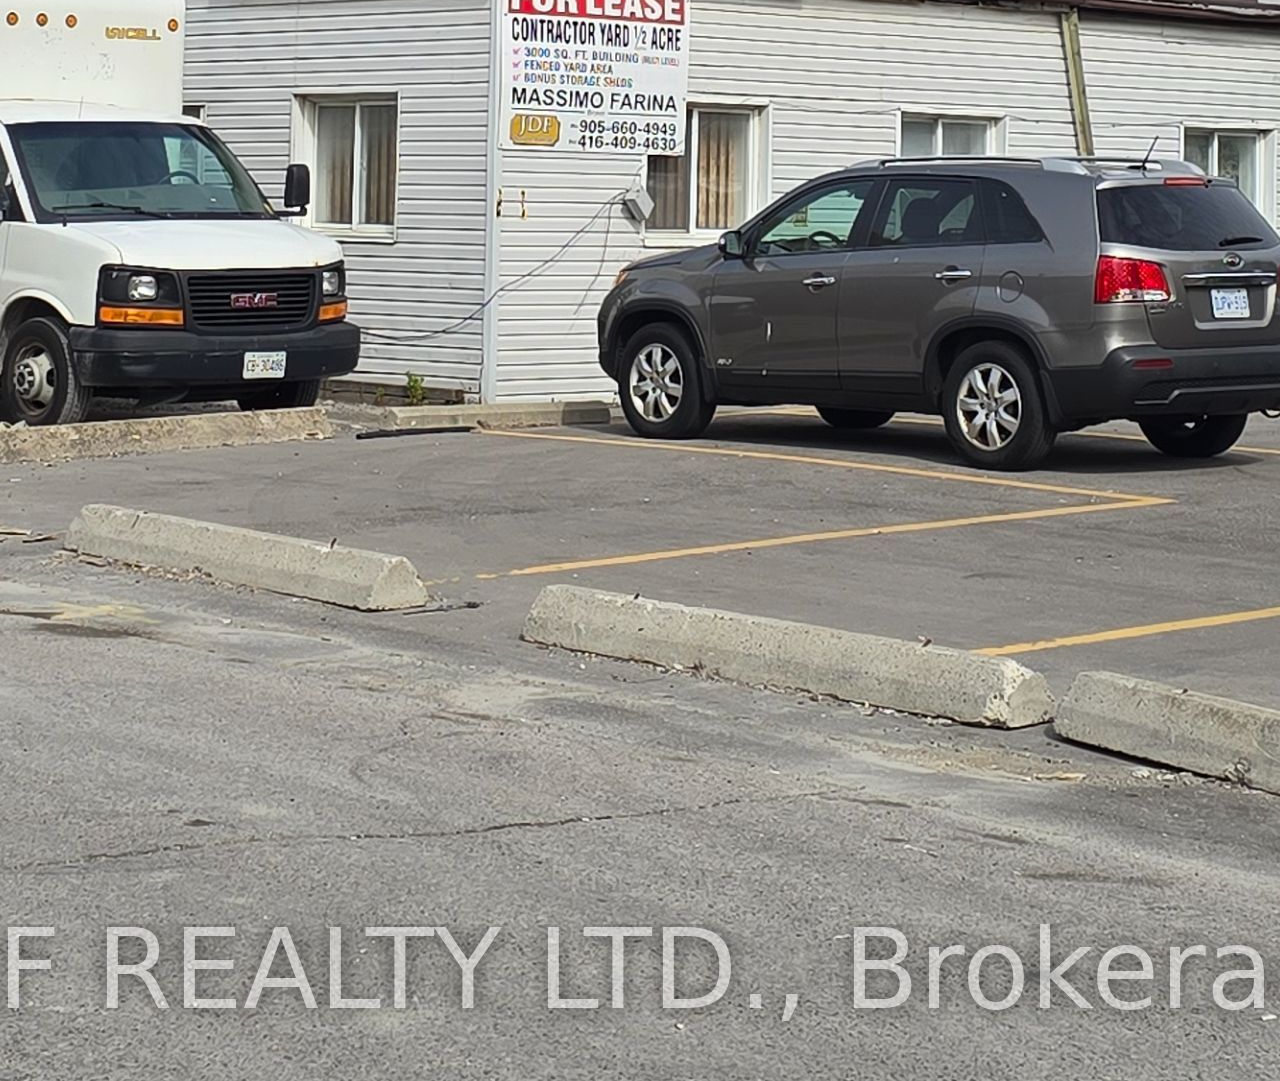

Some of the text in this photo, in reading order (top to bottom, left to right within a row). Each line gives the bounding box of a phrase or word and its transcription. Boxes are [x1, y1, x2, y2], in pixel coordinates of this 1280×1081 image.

[512, 17, 596, 46] CONTRACTOR
[600, 23, 630, 48] YARD
[651, 27, 682, 52] ACRE
[524, 47, 551, 58] 3000
[553, 49, 571, 60] SQ.
[575, 51, 588, 61] FT.
[592, 52, 639, 64] BUILDING
[524, 60, 614, 74] FENCED YARD AREA
[524, 74, 633, 88] BONUS STORAGE SHEDS
[511, 87, 677, 112] MASSIMO FARINA
[579, 120, 677, 136] 905-660-4949
[578, 135, 677, 151] 416-409-4630
[230, 292, 278, 309] GMC
